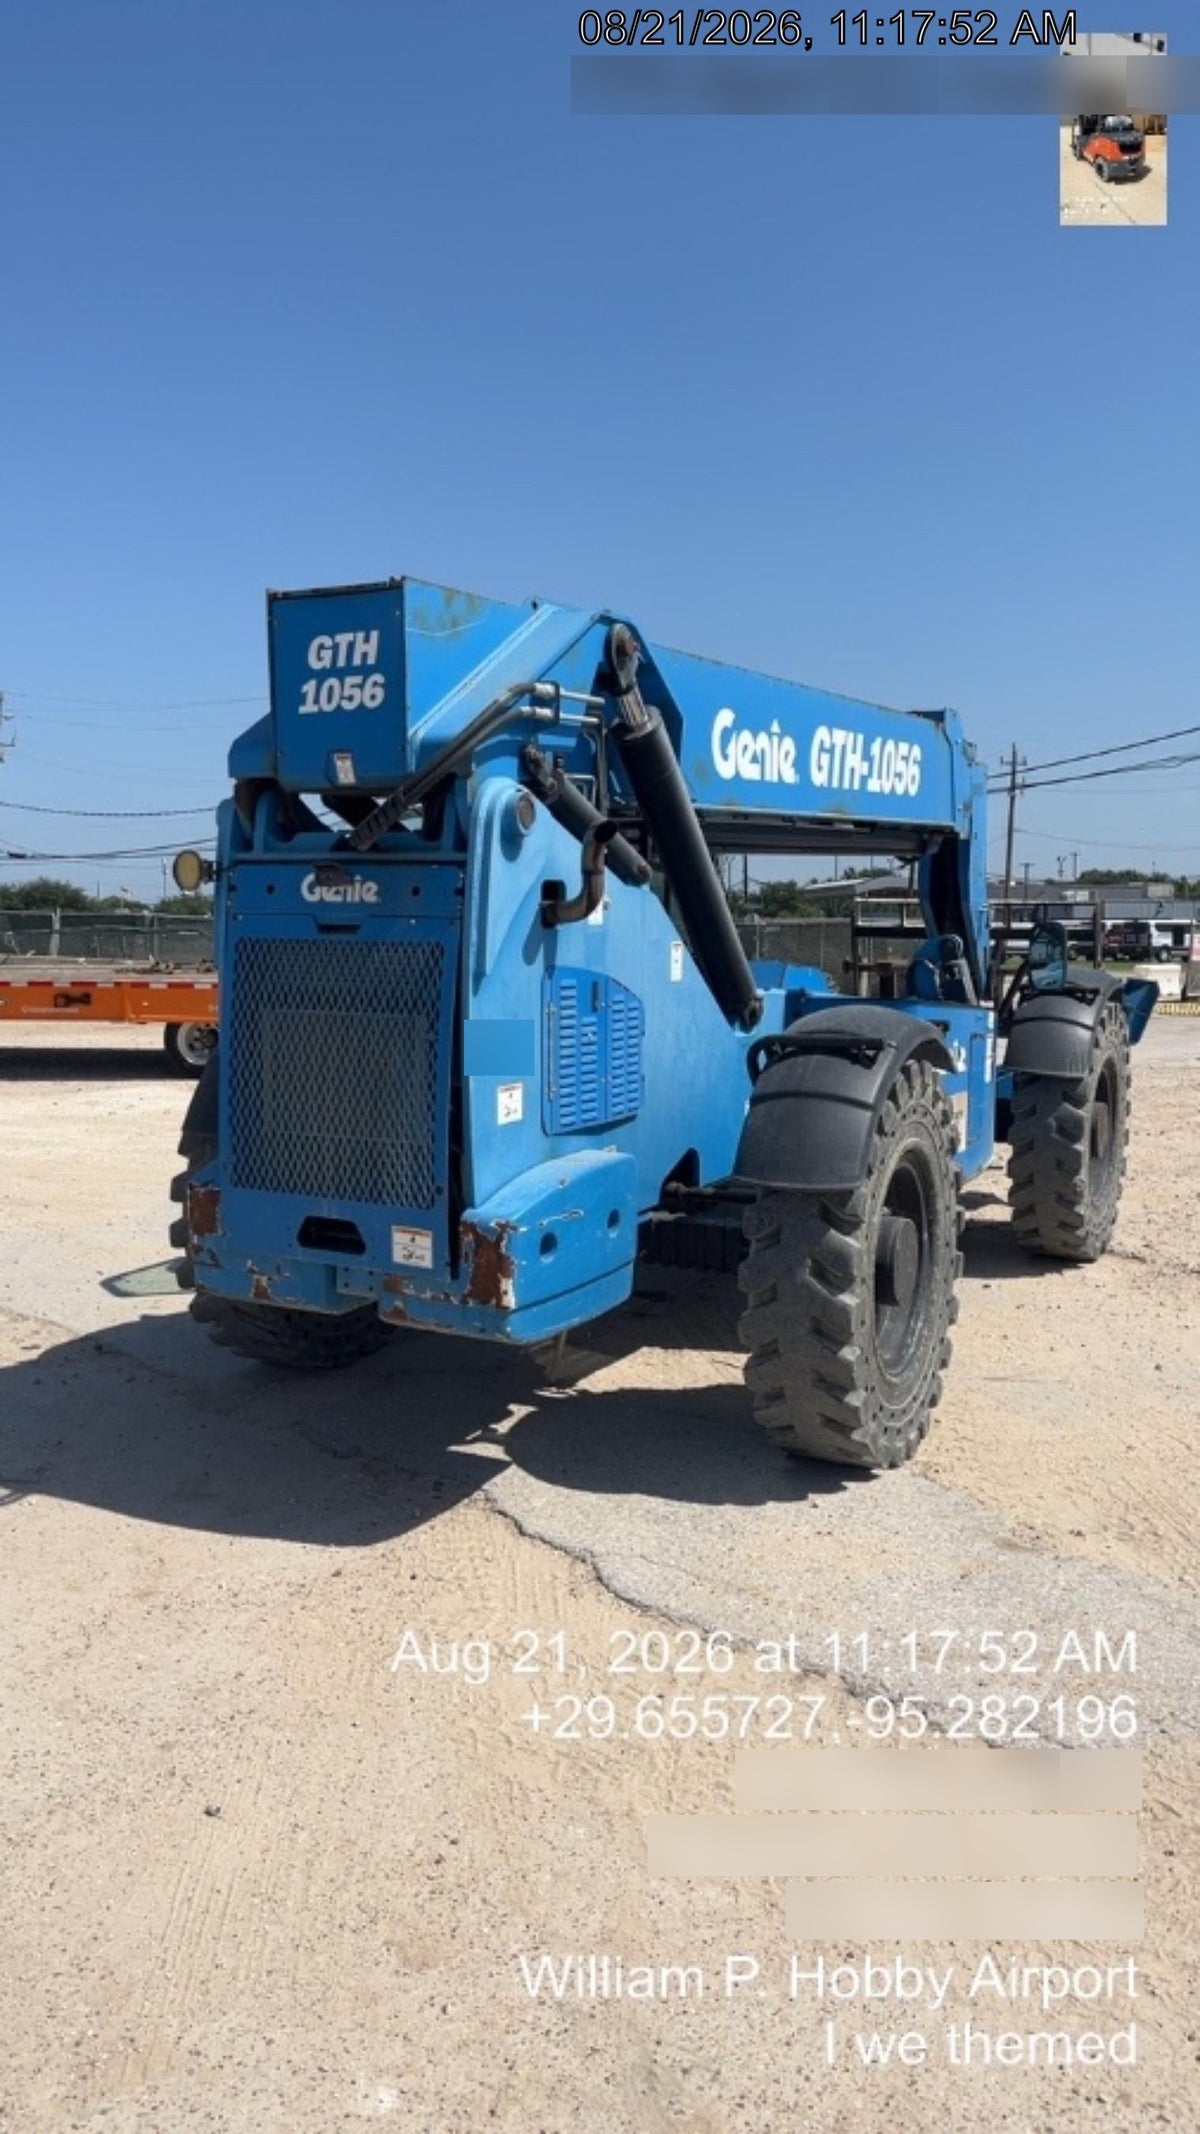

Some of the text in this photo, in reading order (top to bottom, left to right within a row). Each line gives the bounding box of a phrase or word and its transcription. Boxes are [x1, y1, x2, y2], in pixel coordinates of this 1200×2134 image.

[307, 629, 379, 670] GTH
[298, 672, 386, 715] 1056
[710, 707, 922, 798] Genie GTH-1056
